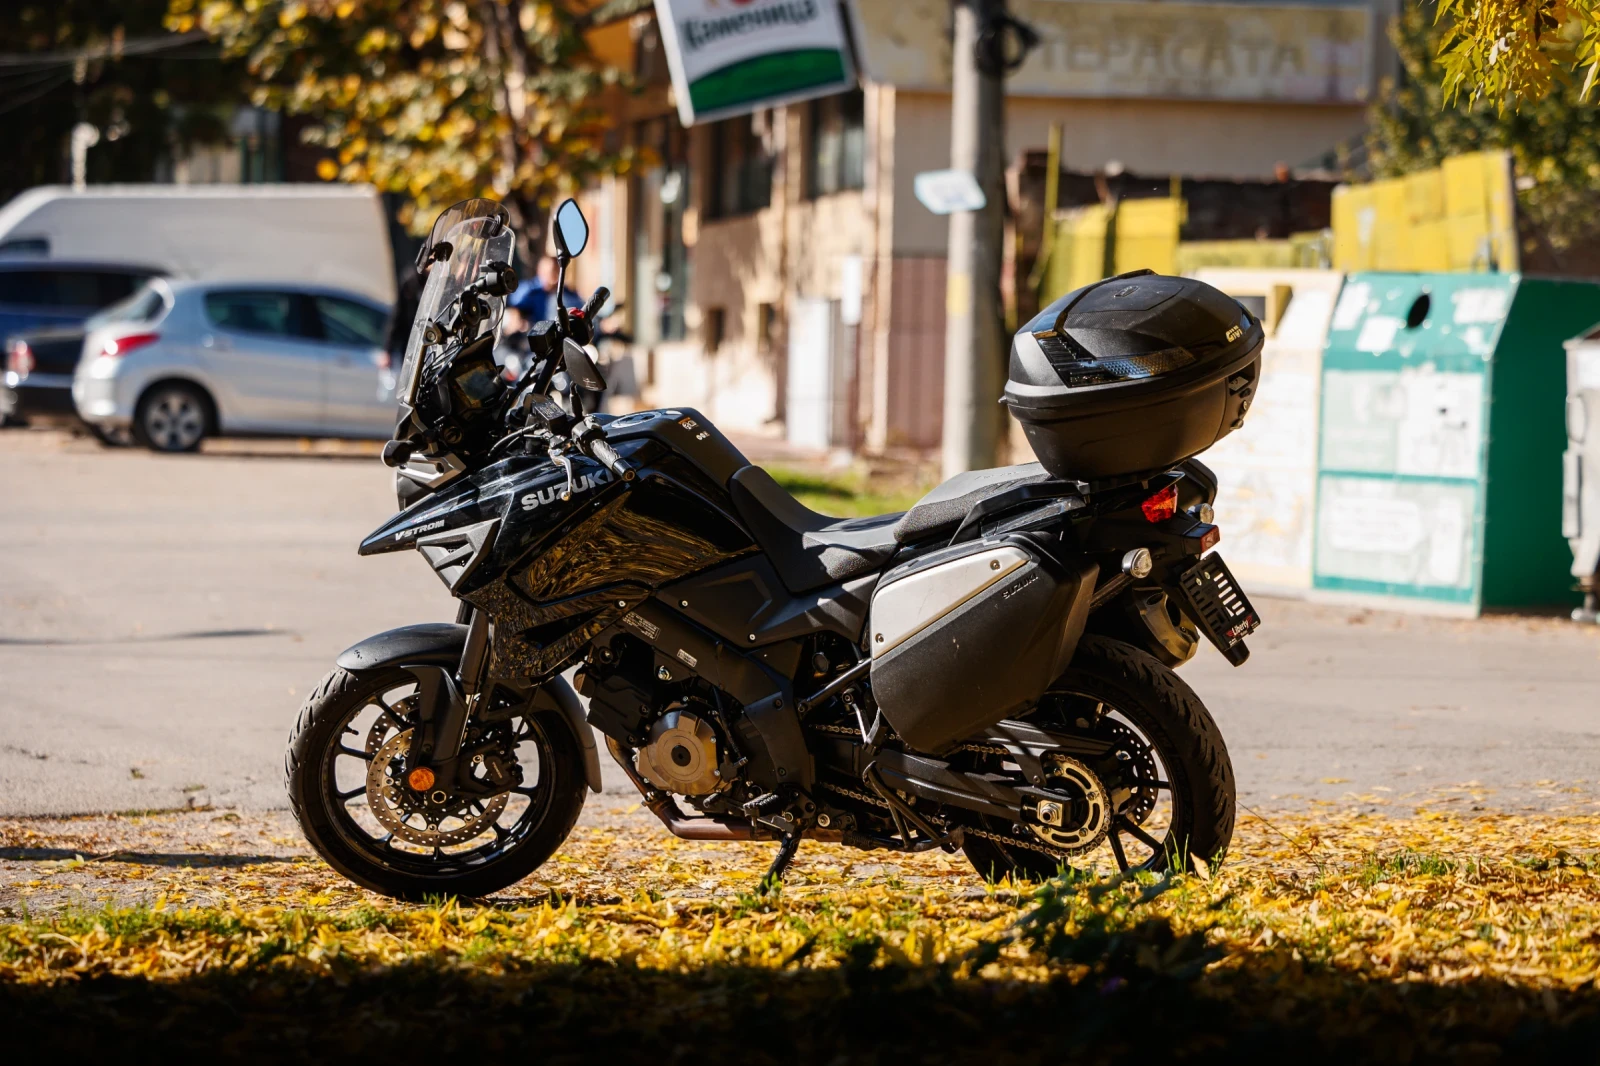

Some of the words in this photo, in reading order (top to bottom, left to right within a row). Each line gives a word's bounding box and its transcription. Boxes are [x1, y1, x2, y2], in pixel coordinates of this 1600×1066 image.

[520, 467, 615, 511] SUZUKI
[395, 519, 445, 541] V-STROM
[1001, 573, 1039, 600] SUZUKI
